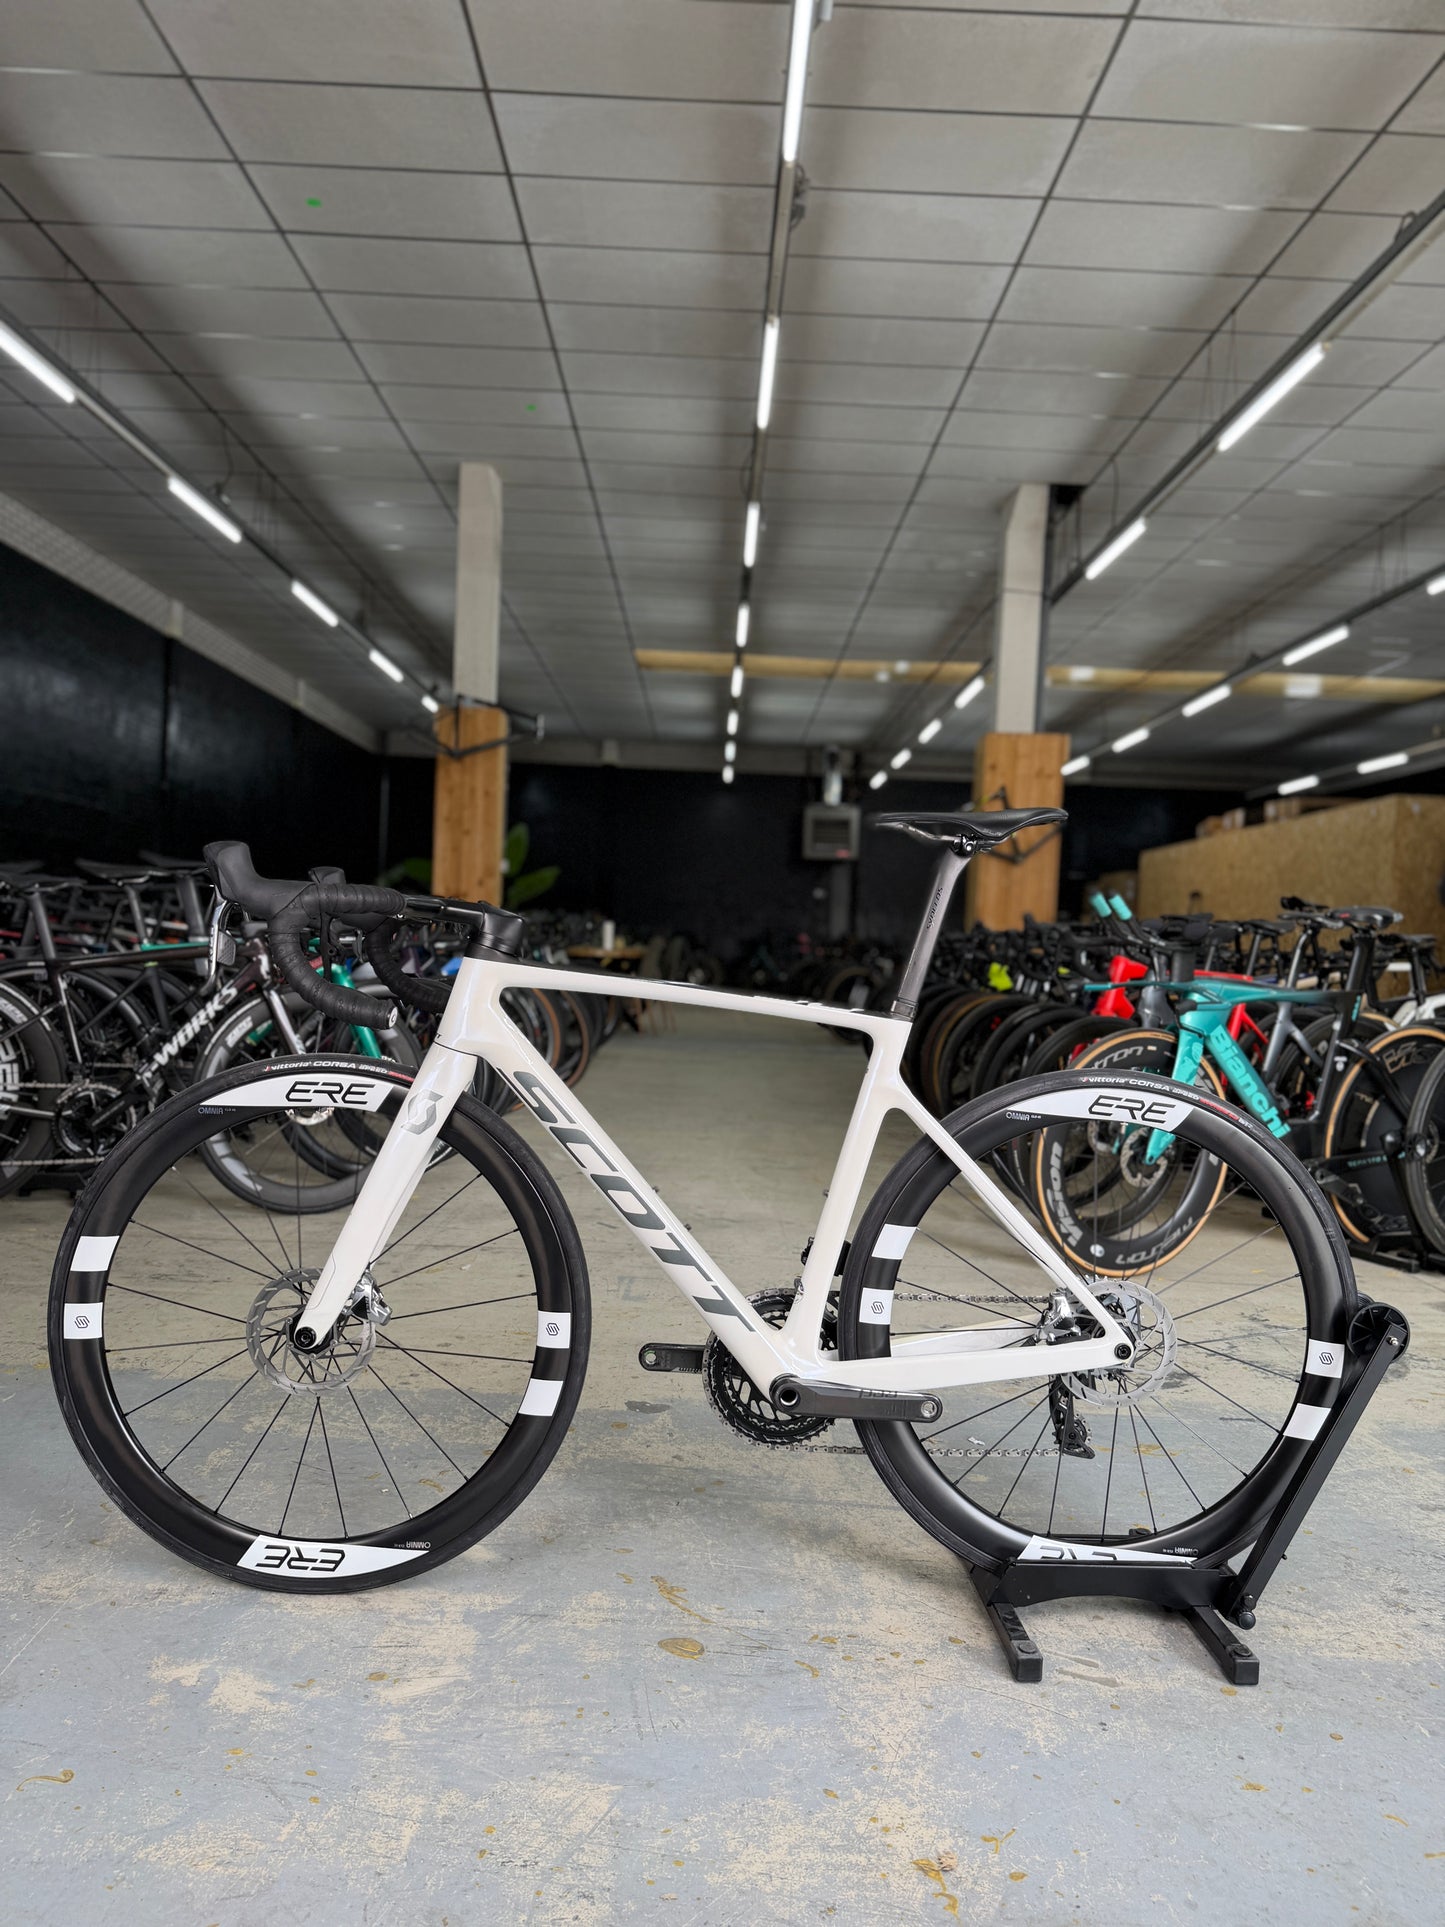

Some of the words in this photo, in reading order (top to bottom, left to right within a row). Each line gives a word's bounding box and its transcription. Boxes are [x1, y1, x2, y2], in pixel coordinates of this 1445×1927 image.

[270, 1061, 310, 1071] vittoria
[313, 1061, 356, 1069] CORSA
[1087, 1076, 1126, 1085] vittoria
[1128, 1078, 1171, 1092] CORSA
[1209, 1024, 1291, 1139] Bianchi
[285, 1080, 376, 1105] ERE
[198, 1106, 224, 1115] OMNIA
[1005, 1111, 1030, 1121] OMNIA
[1088, 1094, 1176, 1124] ERE
[513, 1070, 757, 1332] SCOTT
[405, 1541, 431, 1550] OMNIA
[255, 1544, 346, 1573] ERE
